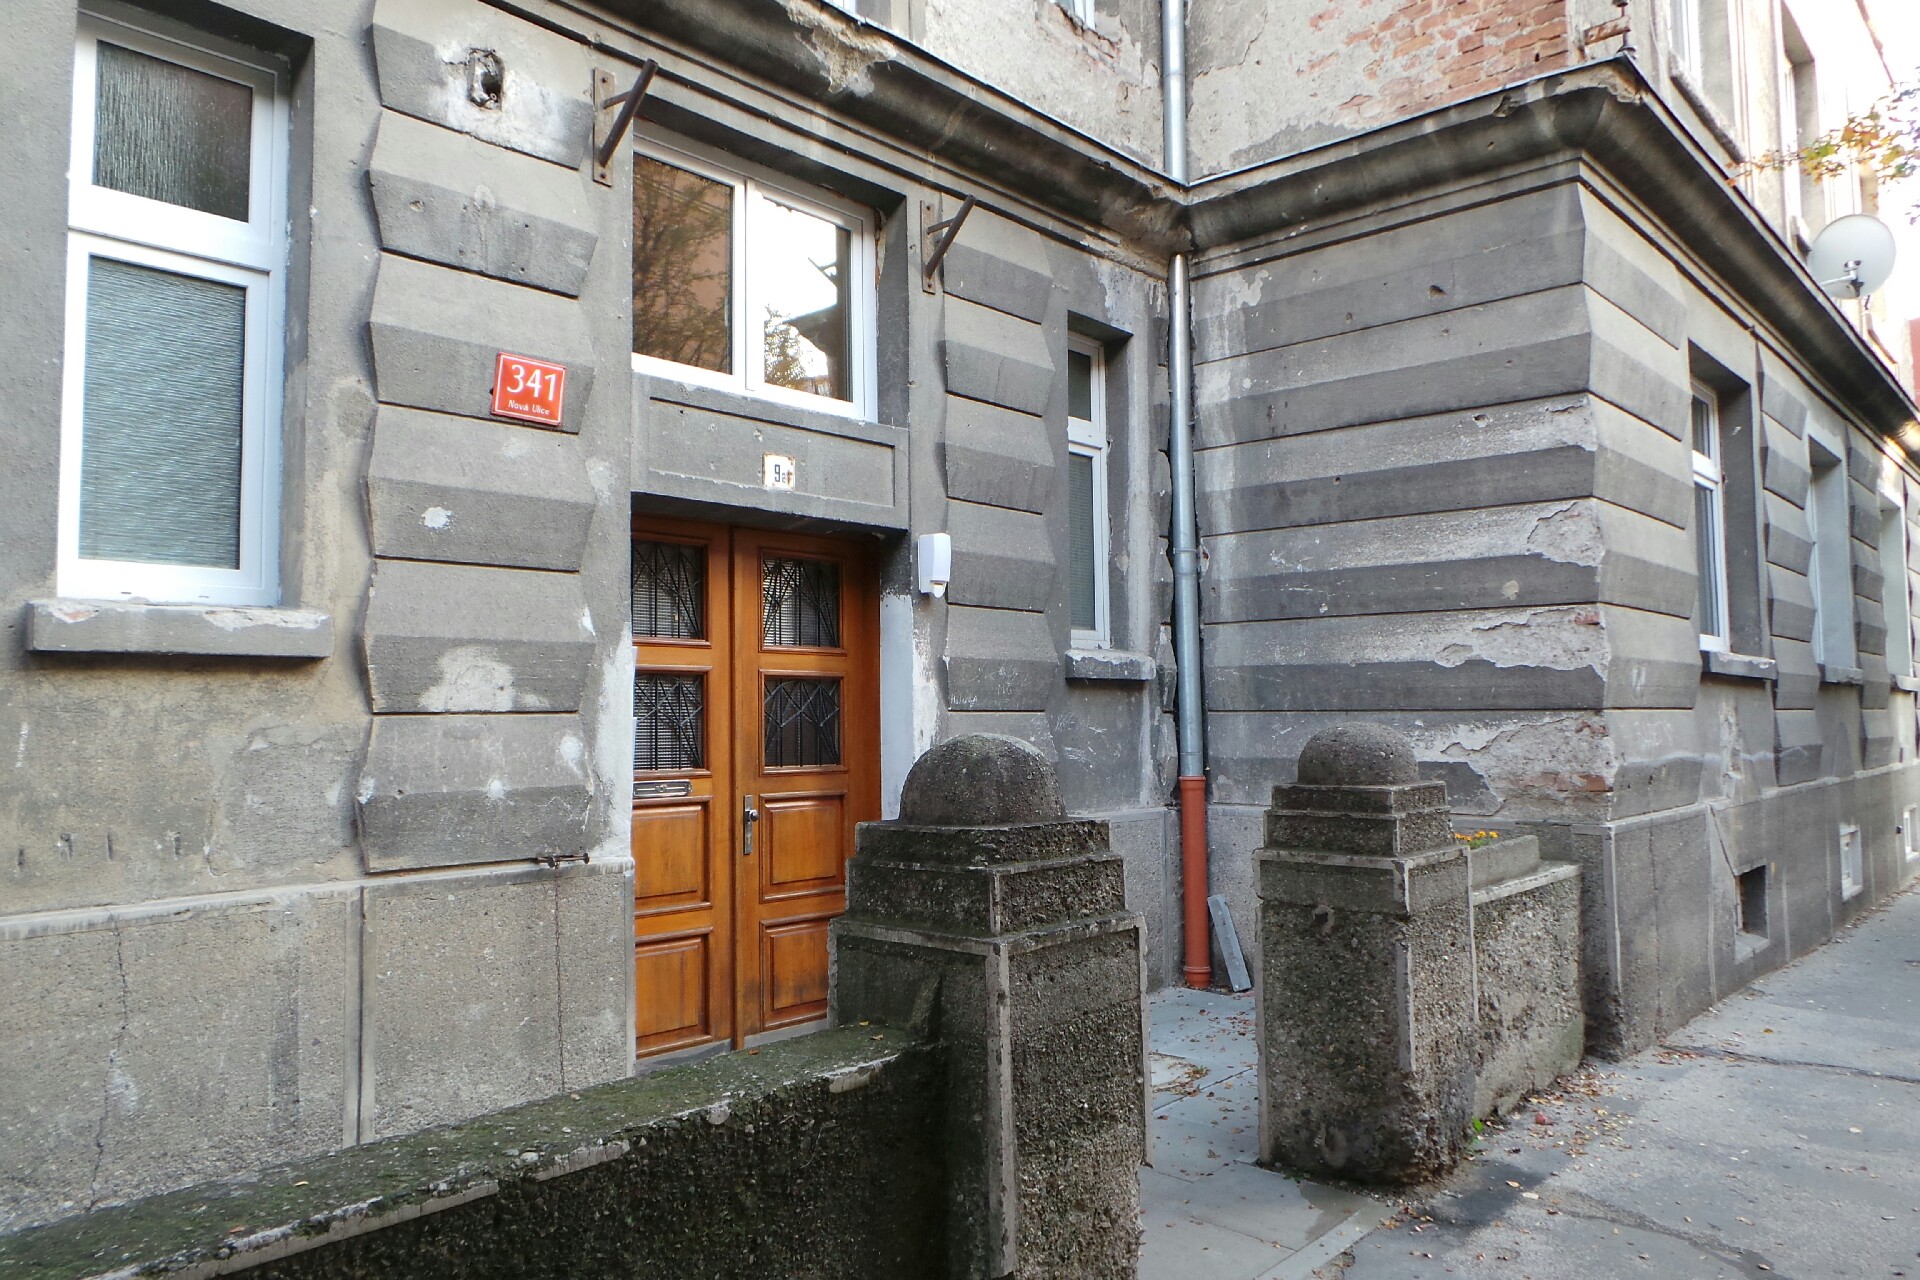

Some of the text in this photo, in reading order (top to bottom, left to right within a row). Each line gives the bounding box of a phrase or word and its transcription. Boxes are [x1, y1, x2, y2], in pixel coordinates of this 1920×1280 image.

[506, 364, 556, 401] 341
[507, 399, 550, 415] Nová Ulice
